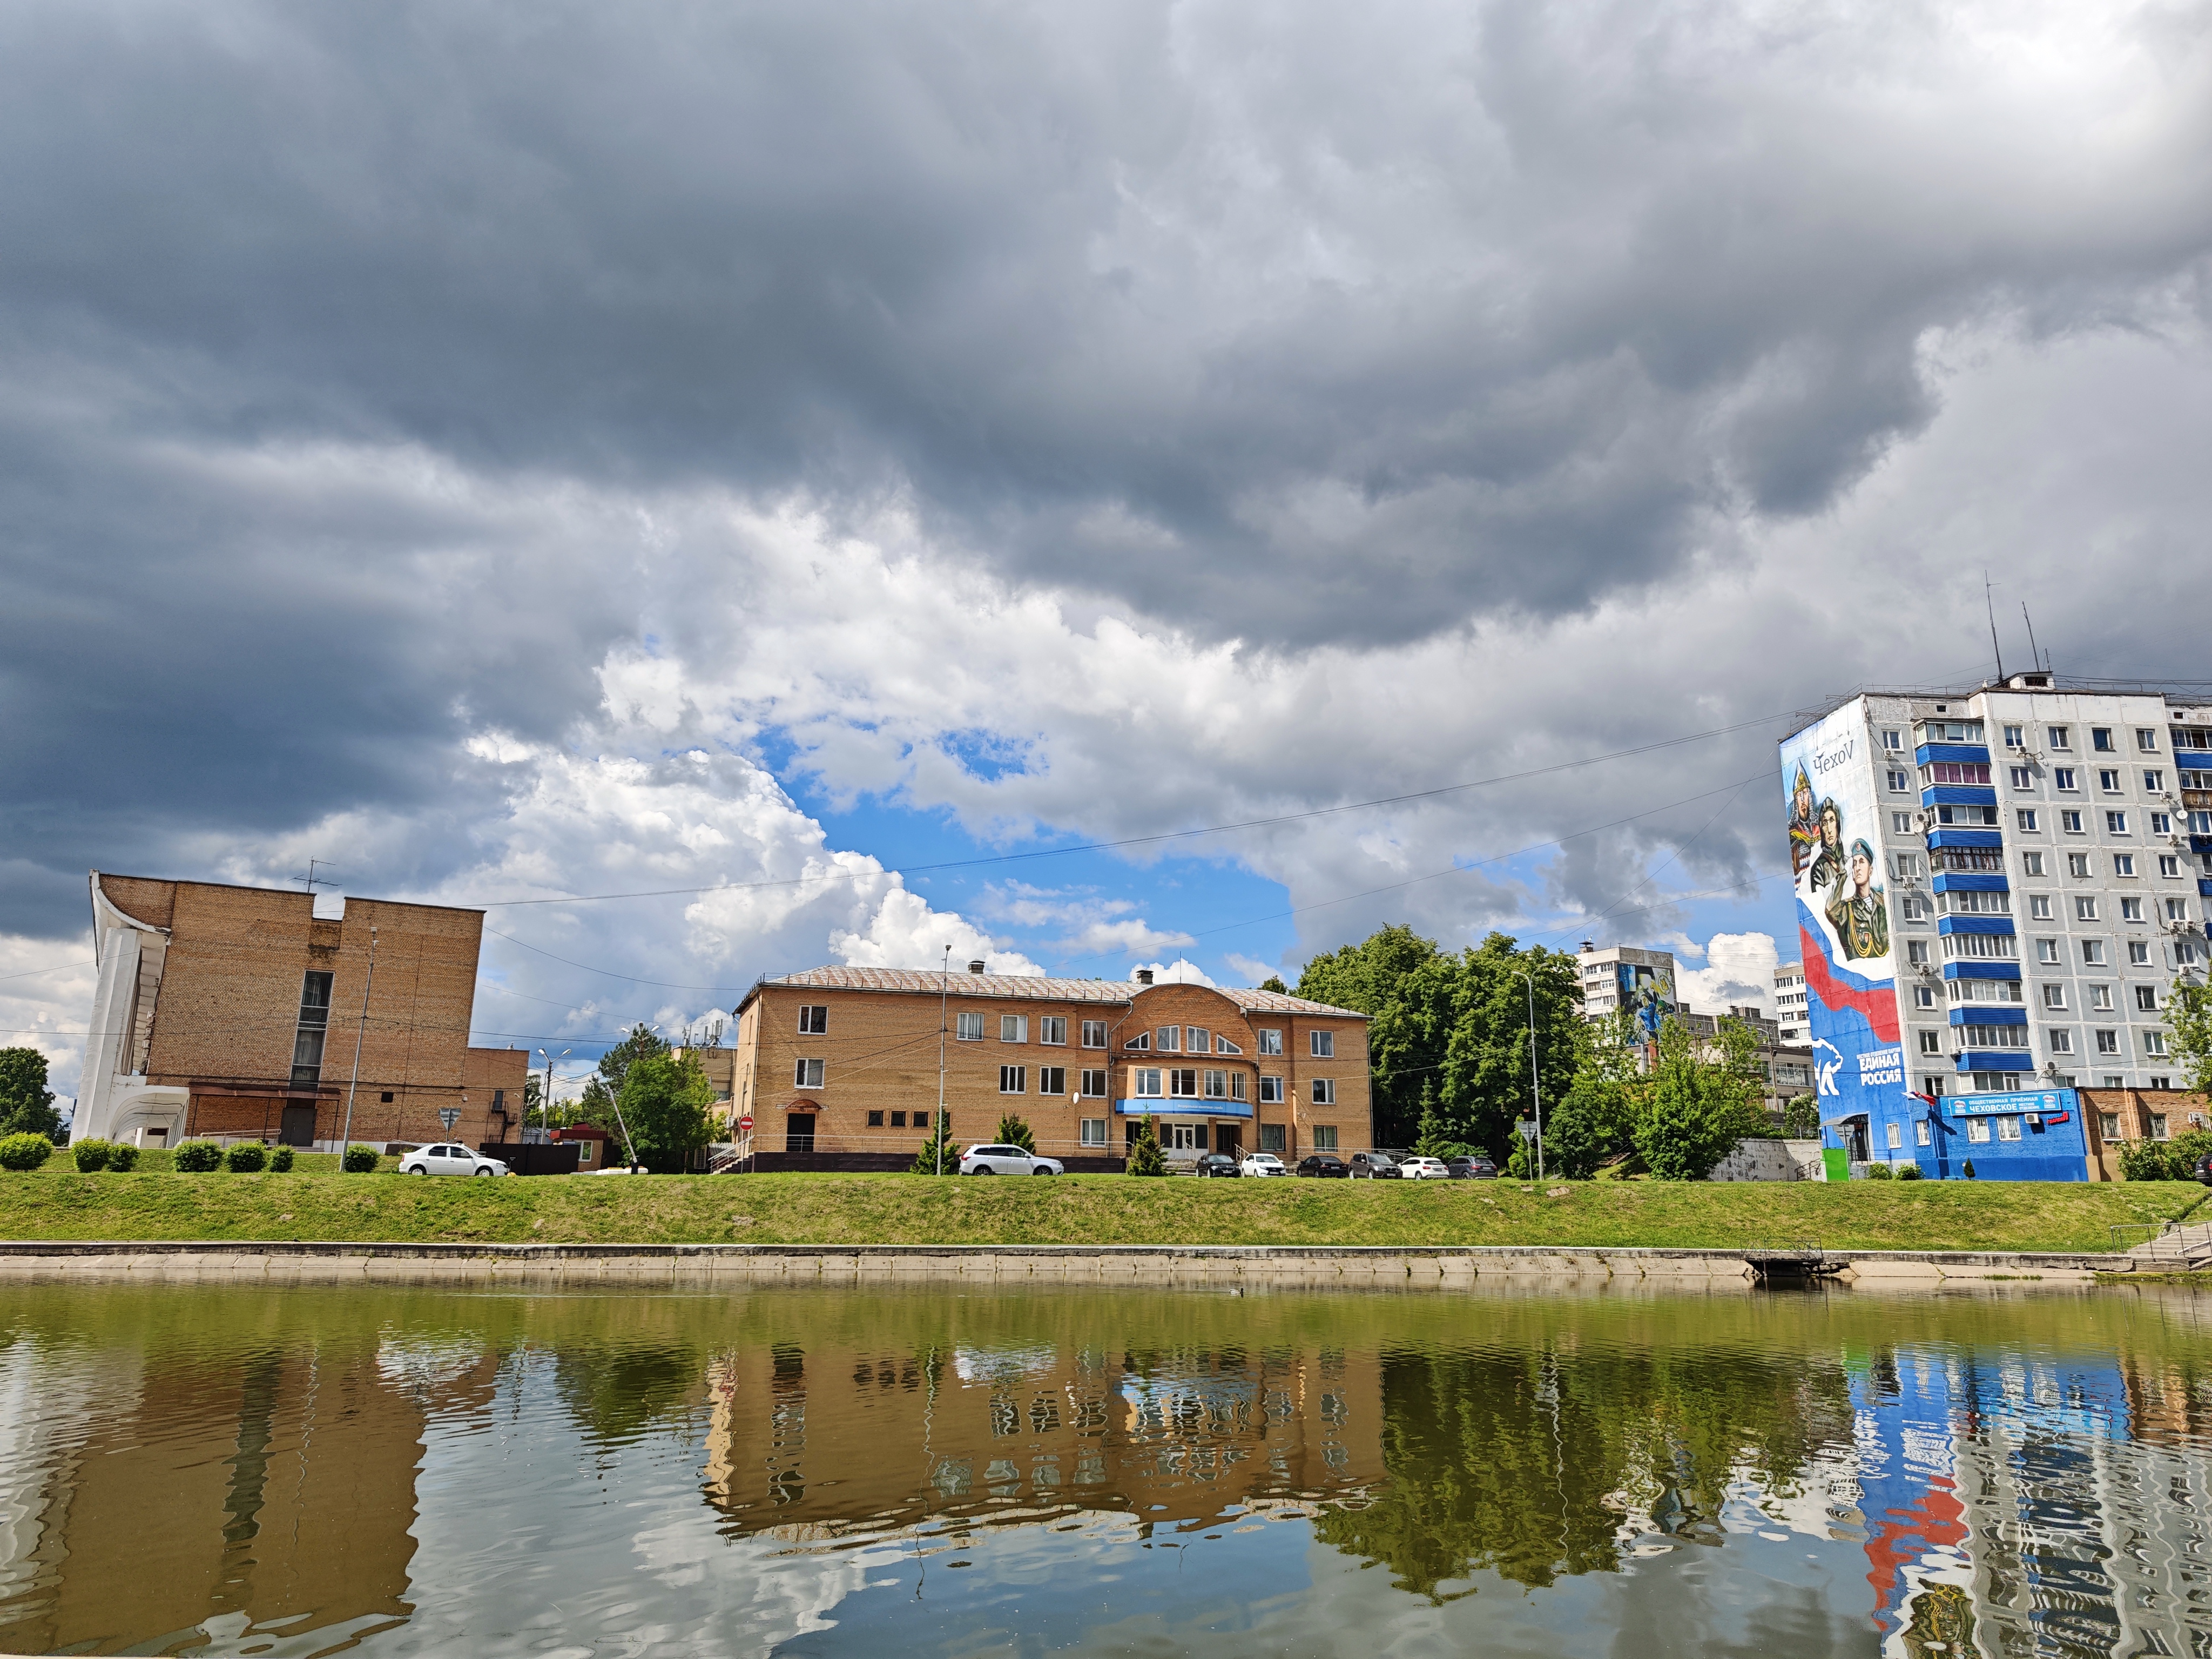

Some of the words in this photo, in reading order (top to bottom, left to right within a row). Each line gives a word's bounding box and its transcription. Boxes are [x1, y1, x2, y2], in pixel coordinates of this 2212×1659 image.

[1859, 1053, 1900, 1071] ЕДИНАЯ
[1860, 1068, 1901, 1086] РОССИЯ
[1970, 1103, 2017, 1112] ЧЕХОВСКОЕ
